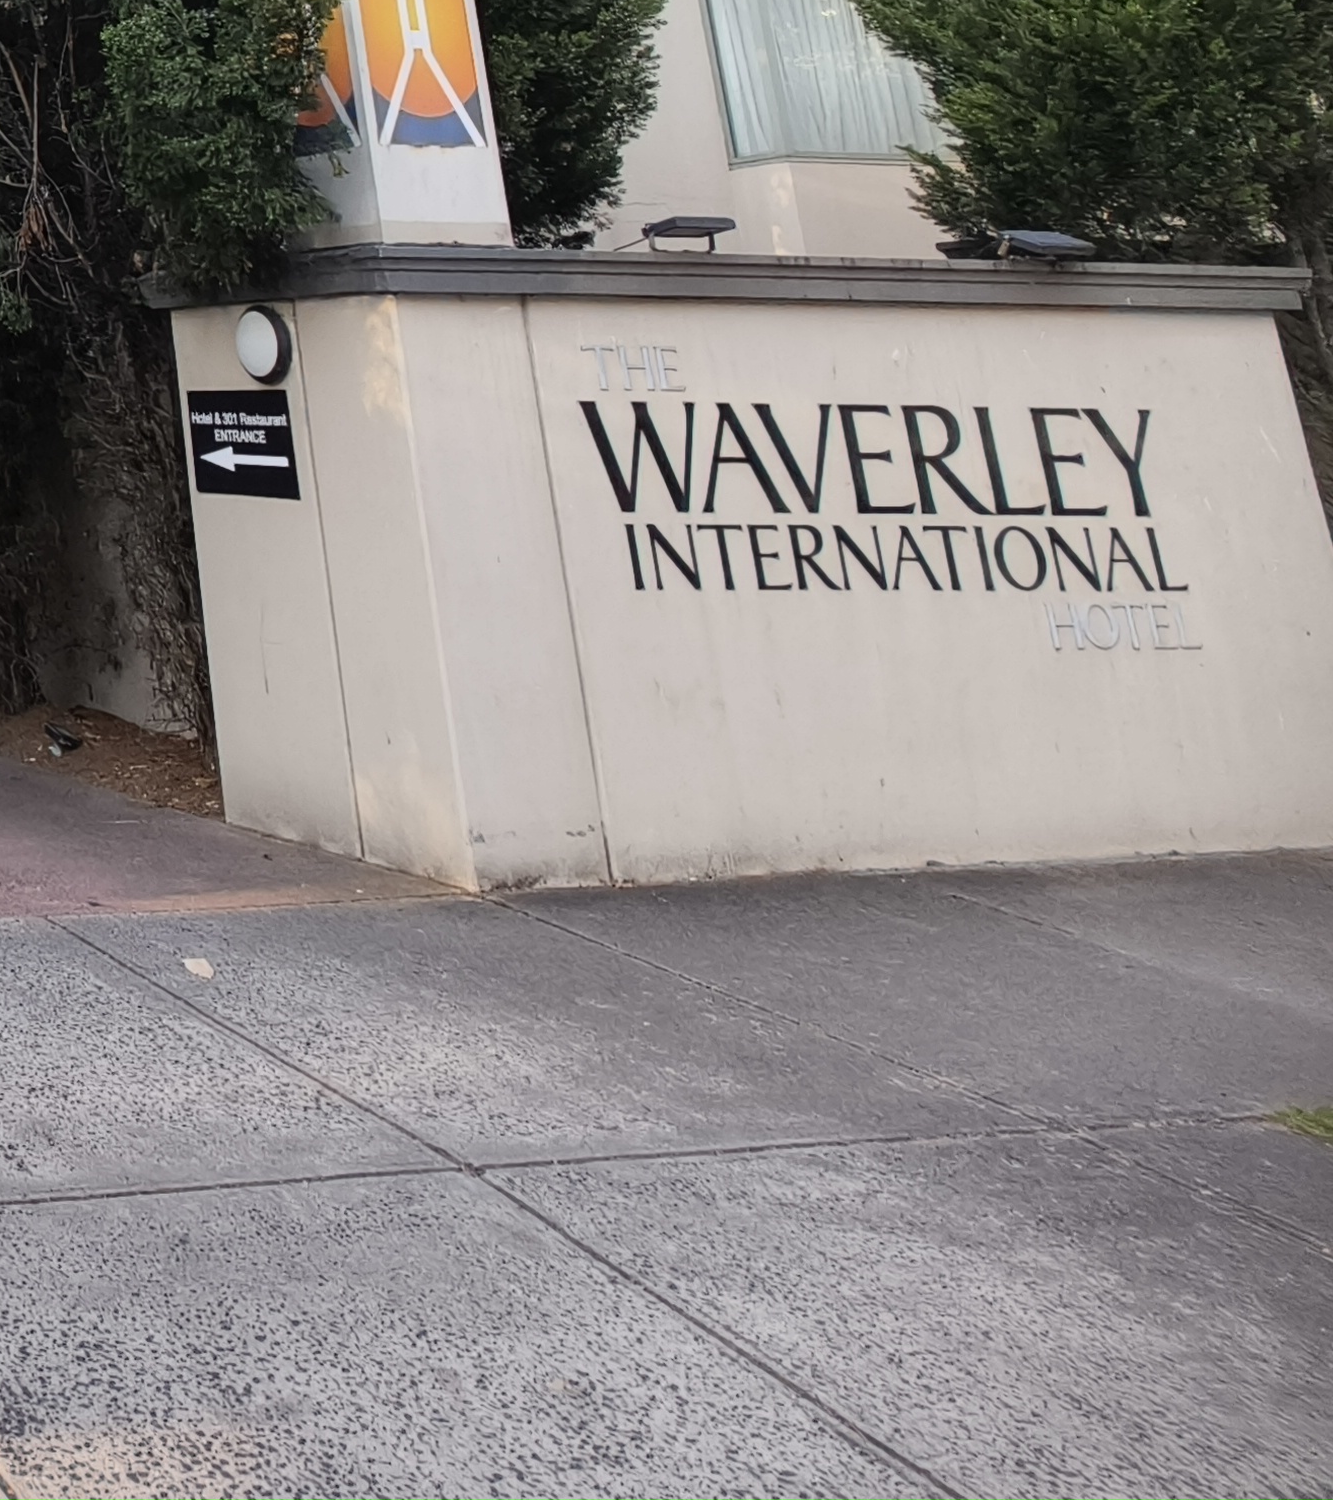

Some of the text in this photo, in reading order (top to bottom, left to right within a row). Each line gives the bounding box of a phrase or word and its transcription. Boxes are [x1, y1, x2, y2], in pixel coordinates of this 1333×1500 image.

[580, 345, 686, 392] THE
[191, 411, 288, 427] Hotel & 301 Restaurant
[214, 429, 267, 444] ENTRANCE
[577, 399, 1152, 518] WAVERLEY
[624, 522, 1190, 592] INTERNATIONAL
[1042, 601, 1203, 651] HOTEL
